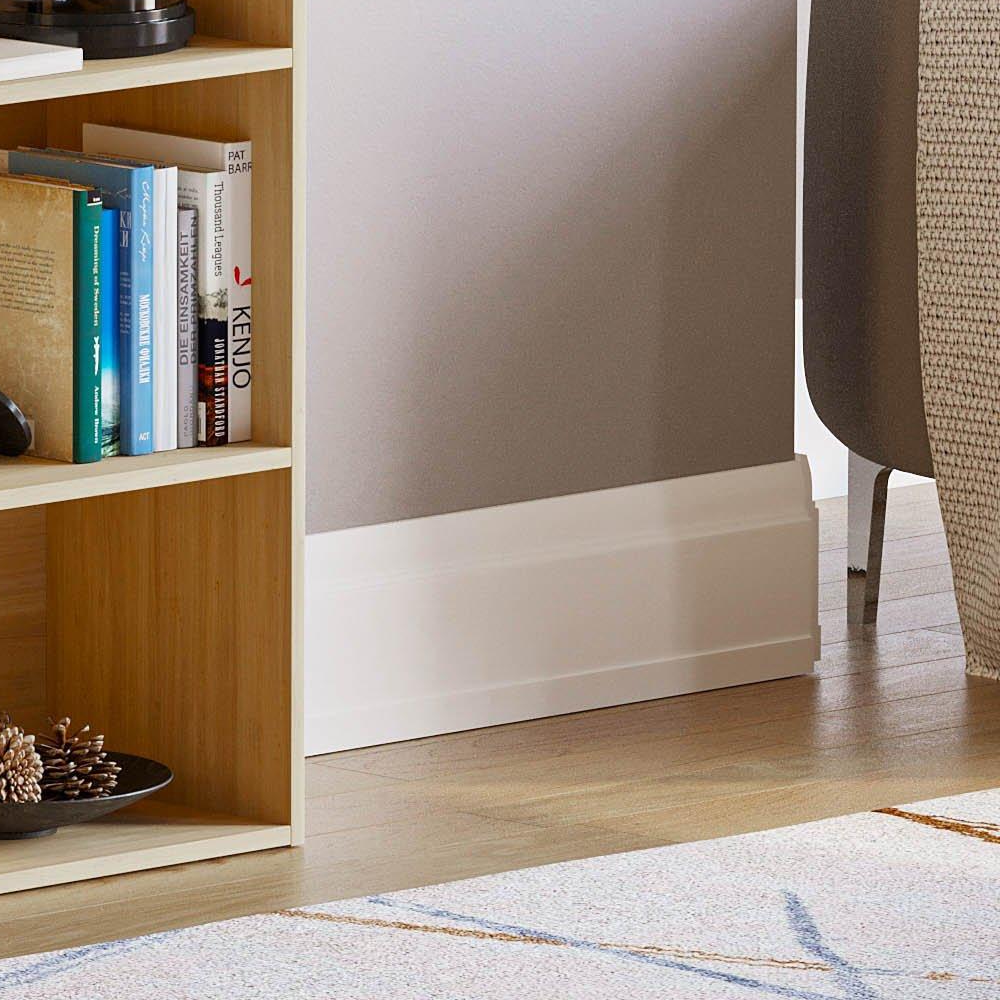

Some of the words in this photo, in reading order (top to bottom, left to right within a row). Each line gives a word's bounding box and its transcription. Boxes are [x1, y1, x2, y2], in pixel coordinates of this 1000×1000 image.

[228, 150, 245, 161] PAT
[214, 181, 224, 233] Thousand
[212, 235, 224, 277] Leagues
[180, 231, 189, 334] EINSAMKEIT
[180, 338, 189, 366] DIE
[214, 337, 225, 384] JONATHAN
[232, 306, 252, 389] KENJO
[214, 385, 225, 438] STANDFORD
